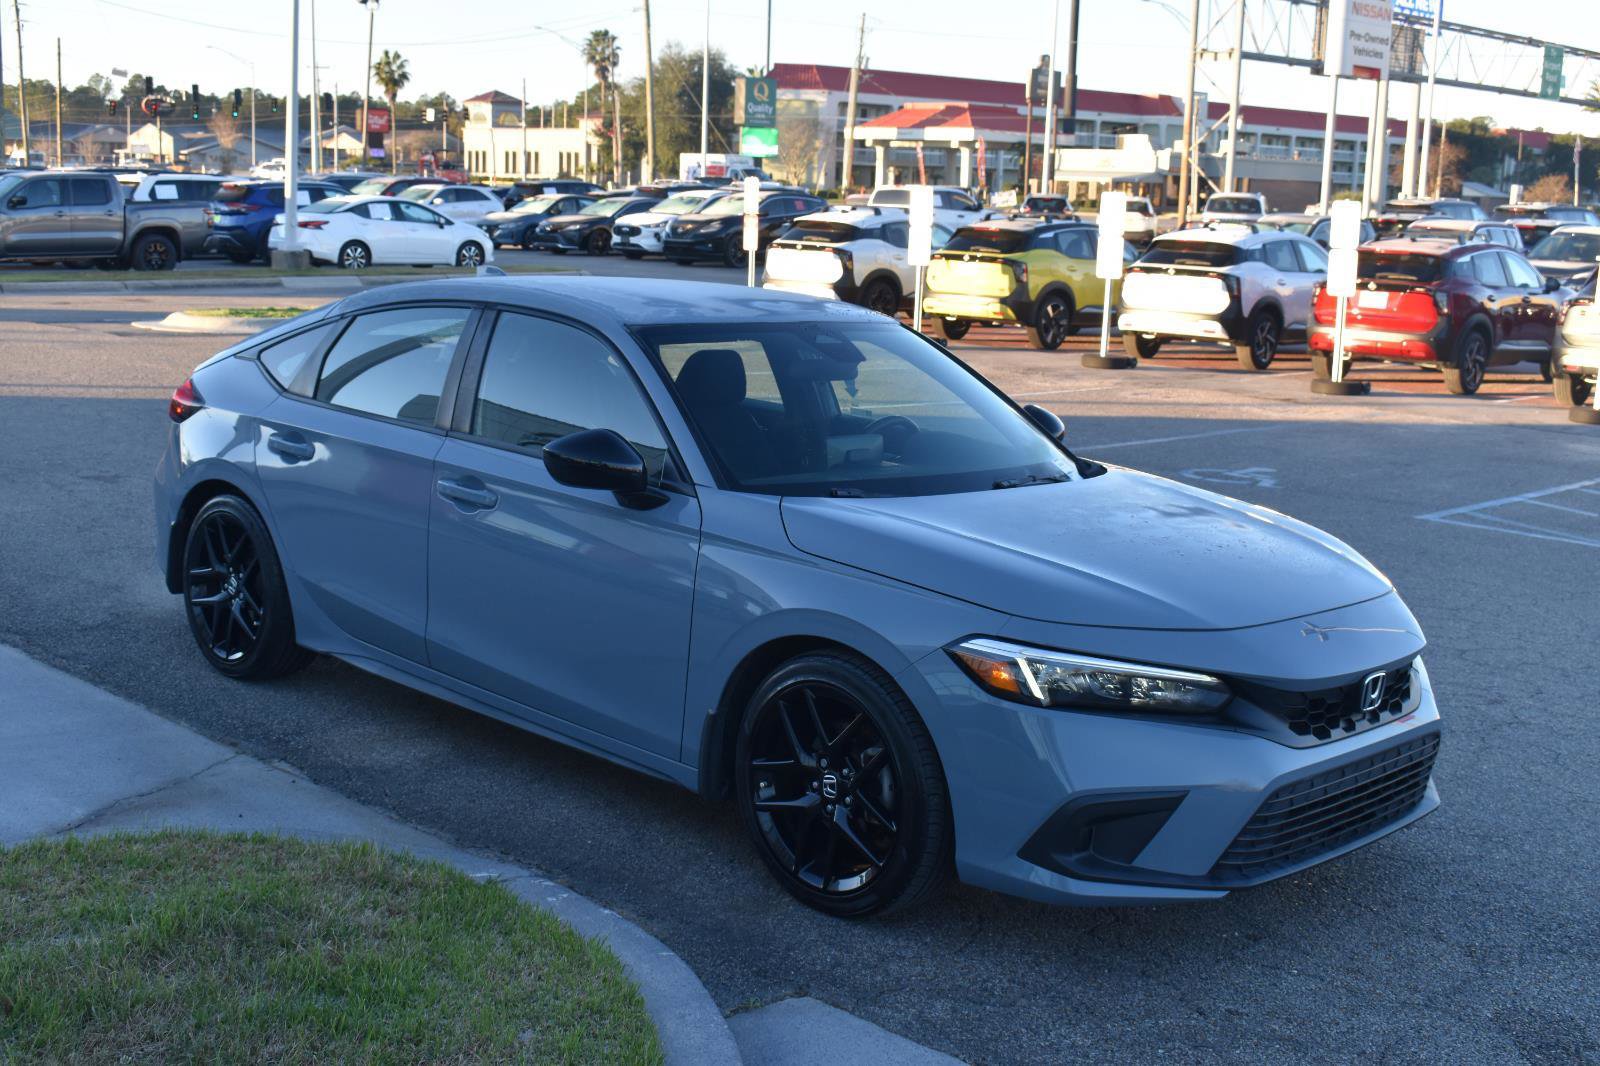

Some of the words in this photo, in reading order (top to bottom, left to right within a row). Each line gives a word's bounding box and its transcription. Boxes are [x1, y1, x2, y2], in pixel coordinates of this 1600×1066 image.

[1352, 1, 1391, 20] NISSAN
[1349, 30, 1389, 46] Pre-Owned
[1353, 46, 1384, 59] Vehicles
[747, 102, 773, 115] Quality
